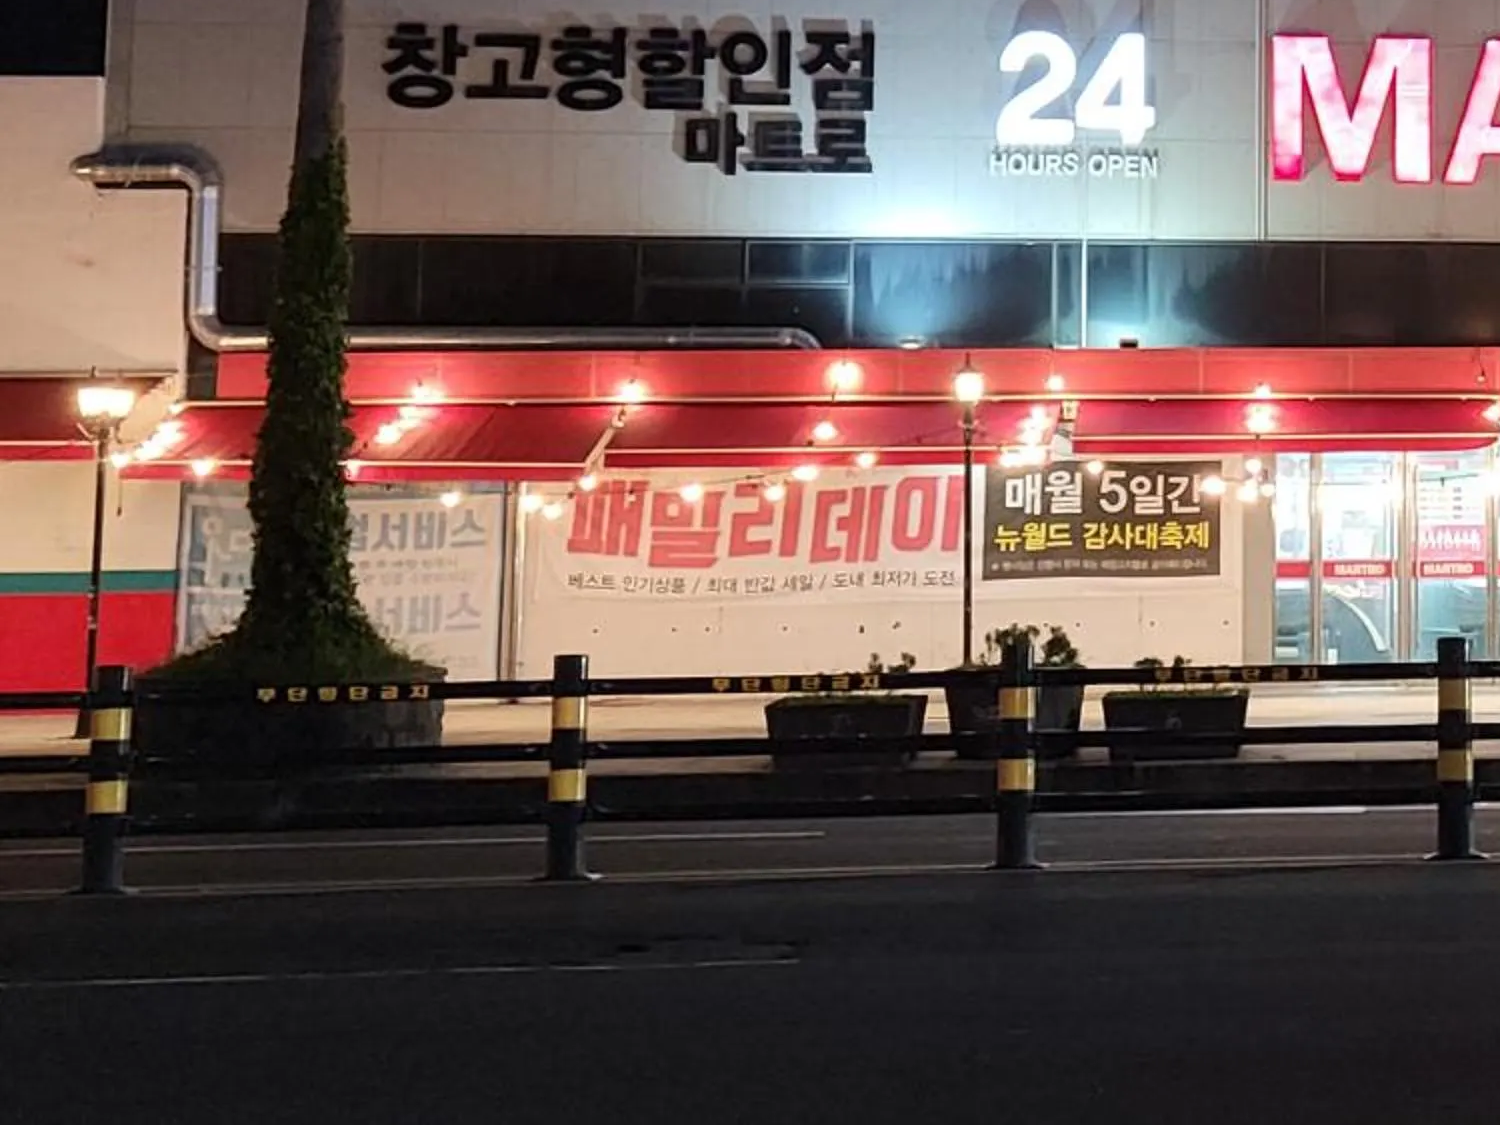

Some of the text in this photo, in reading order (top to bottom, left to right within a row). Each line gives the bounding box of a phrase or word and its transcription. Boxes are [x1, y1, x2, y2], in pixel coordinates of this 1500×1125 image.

[382, 22, 874, 111] 창고형할인점
[996, 31, 1156, 146] 24
[684, 112, 873, 174] 마트로
[990, 151, 1158, 178] HOURS OPEN
[1005, 470, 1202, 515] 매월 5일간
[567, 474, 964, 567] 패밀리데이
[994, 521, 1209, 552] 뉴월드 감사대축제
[568, 573, 616, 590] 베스트
[622, 575, 685, 594] 인기상품
[707, 577, 738, 593] 최대
[781, 574, 813, 592] 세일
[832, 571, 865, 588] 도내
